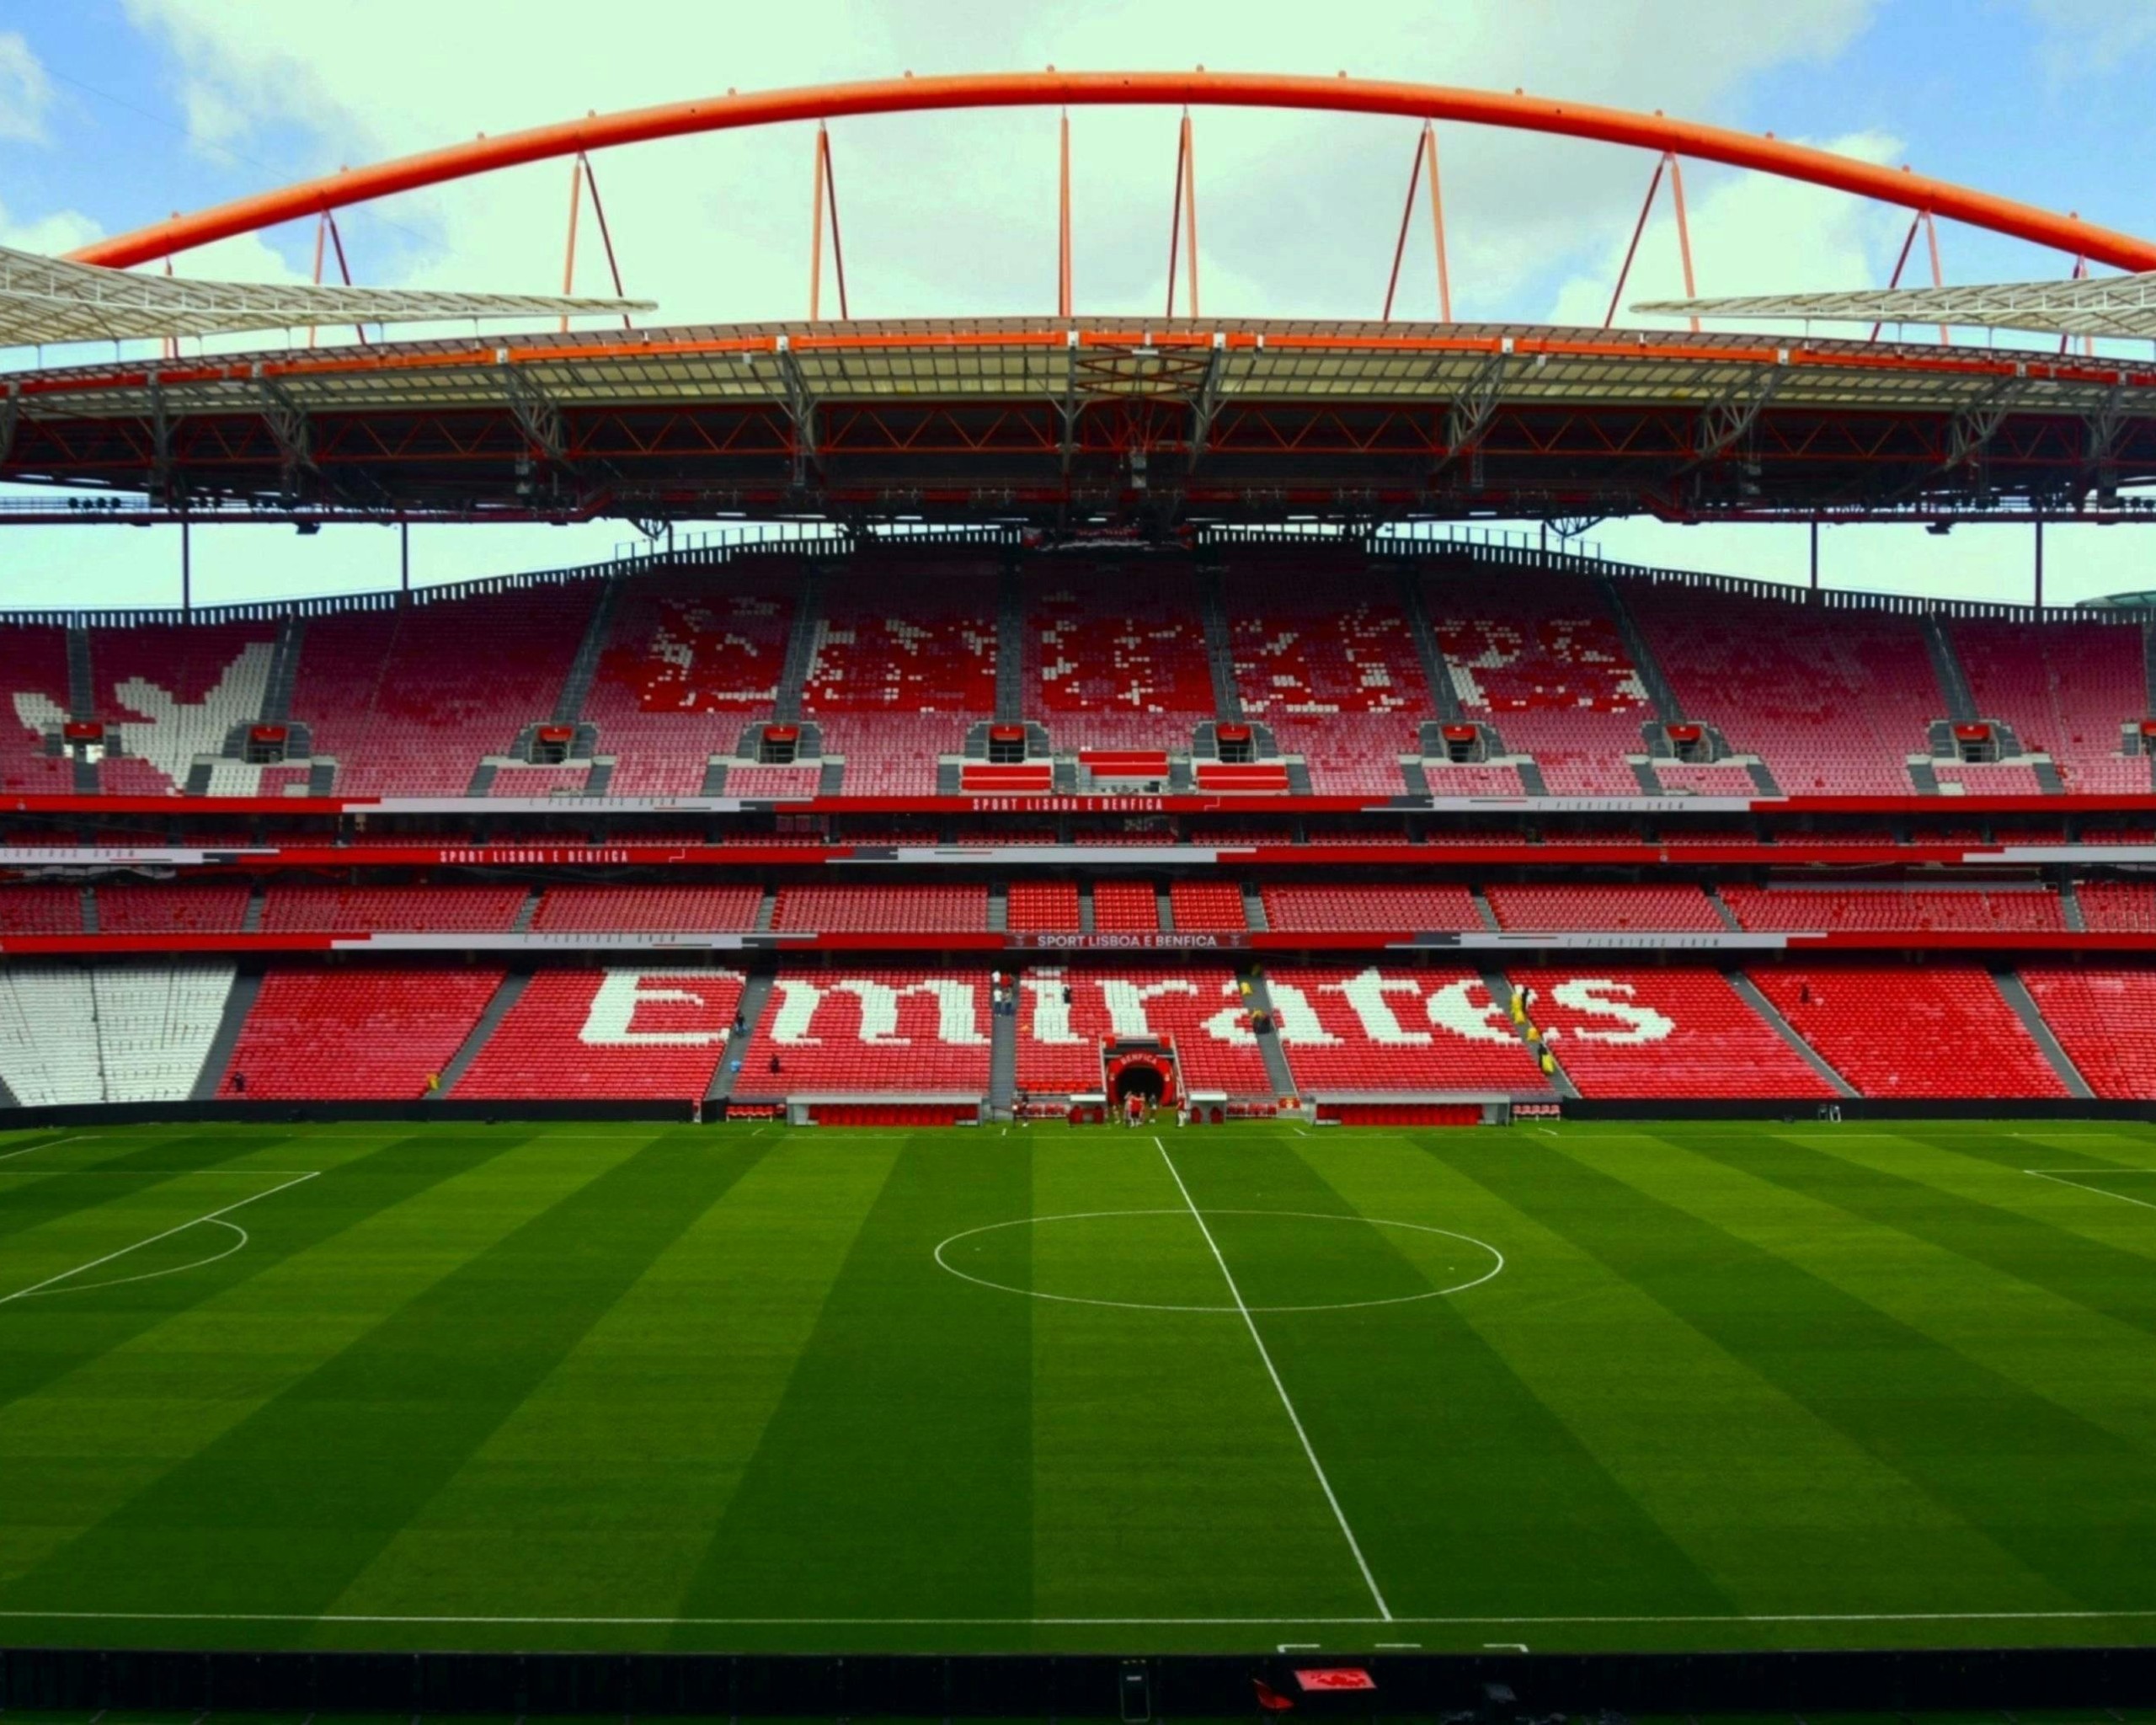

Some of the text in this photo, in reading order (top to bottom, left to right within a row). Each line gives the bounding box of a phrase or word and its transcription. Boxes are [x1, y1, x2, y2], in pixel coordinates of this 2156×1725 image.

[972, 798, 1164, 811] SPORT LISBOA E BENFICA
[440, 850, 629, 863] SPORT LISBOA E BENFICA
[1037, 935, 1217, 948] SPORT LISBOA E BENFICA
[578, 968, 1676, 1048] Emirates
[1120, 1053, 1158, 1065] BENFICA
